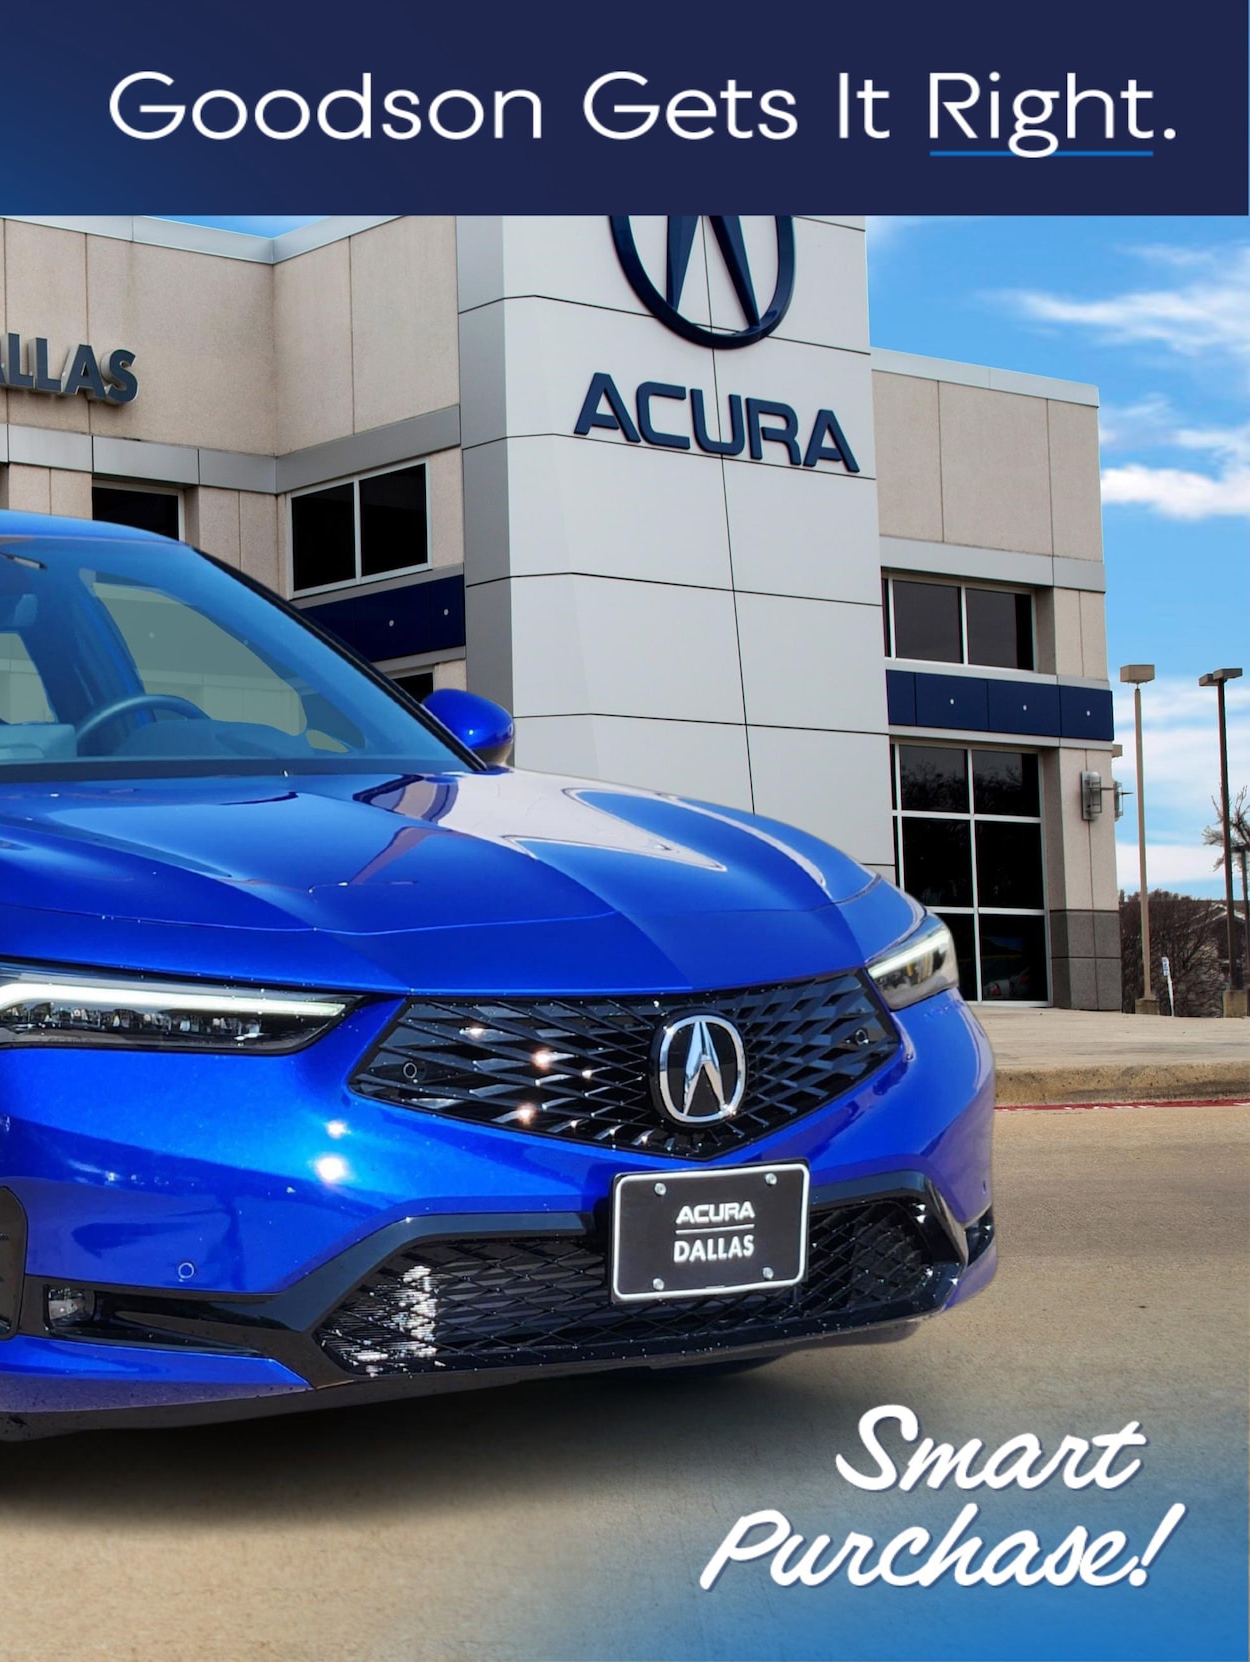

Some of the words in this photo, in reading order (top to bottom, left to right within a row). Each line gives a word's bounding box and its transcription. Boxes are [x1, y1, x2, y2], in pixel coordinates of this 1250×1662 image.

[573, 372, 860, 473] ACURA
[675, 1201, 756, 1224] ACURA
[673, 1234, 755, 1263] DALLAS
